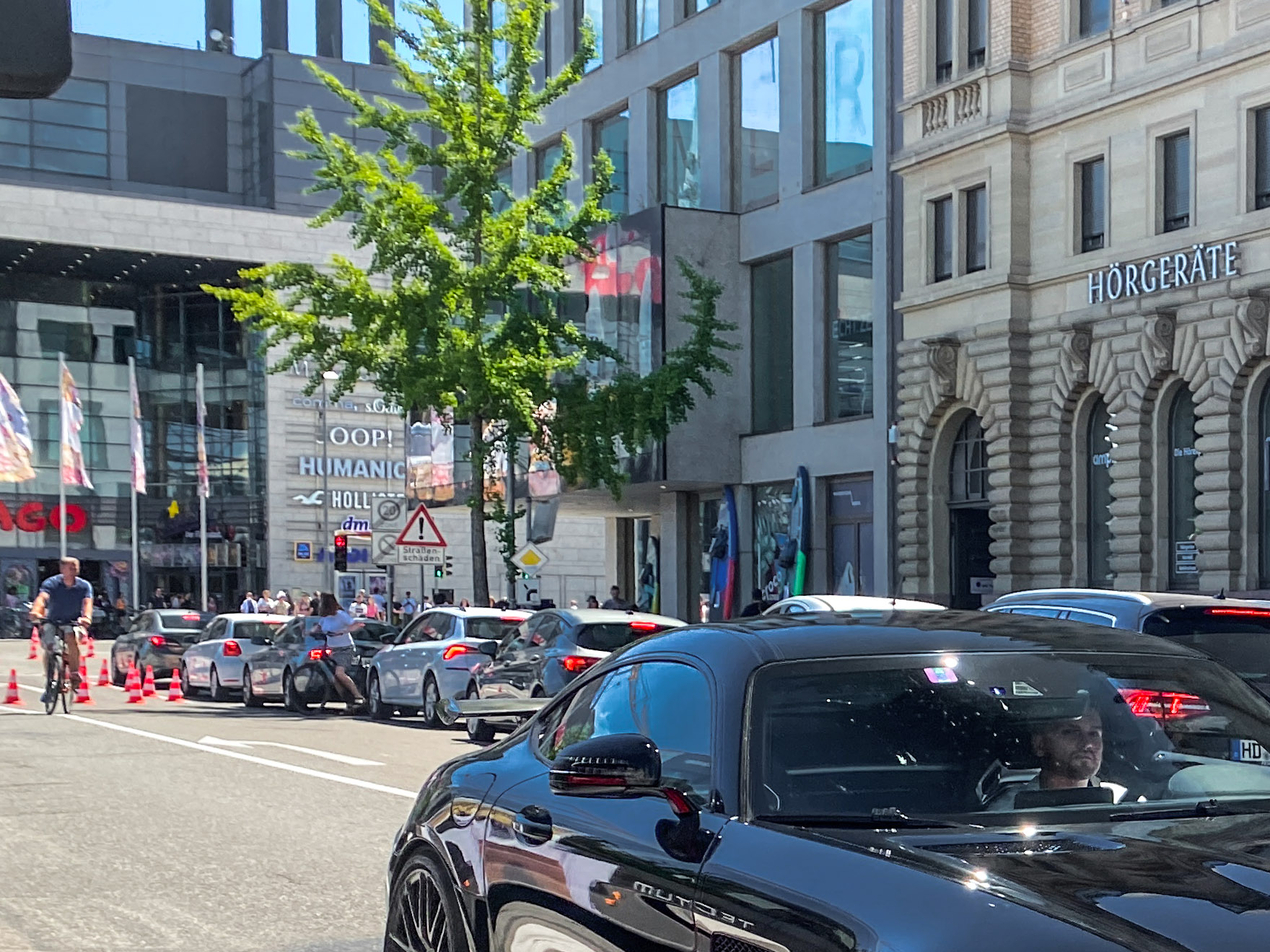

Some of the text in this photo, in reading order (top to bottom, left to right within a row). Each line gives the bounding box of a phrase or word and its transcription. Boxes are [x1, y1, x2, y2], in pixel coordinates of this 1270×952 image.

[1088, 241, 1237, 304] HÖRGERÄTE
[316, 427, 393, 448] OOP!
[342, 516, 369, 531] dm
[1241, 742, 1262, 759] HD
